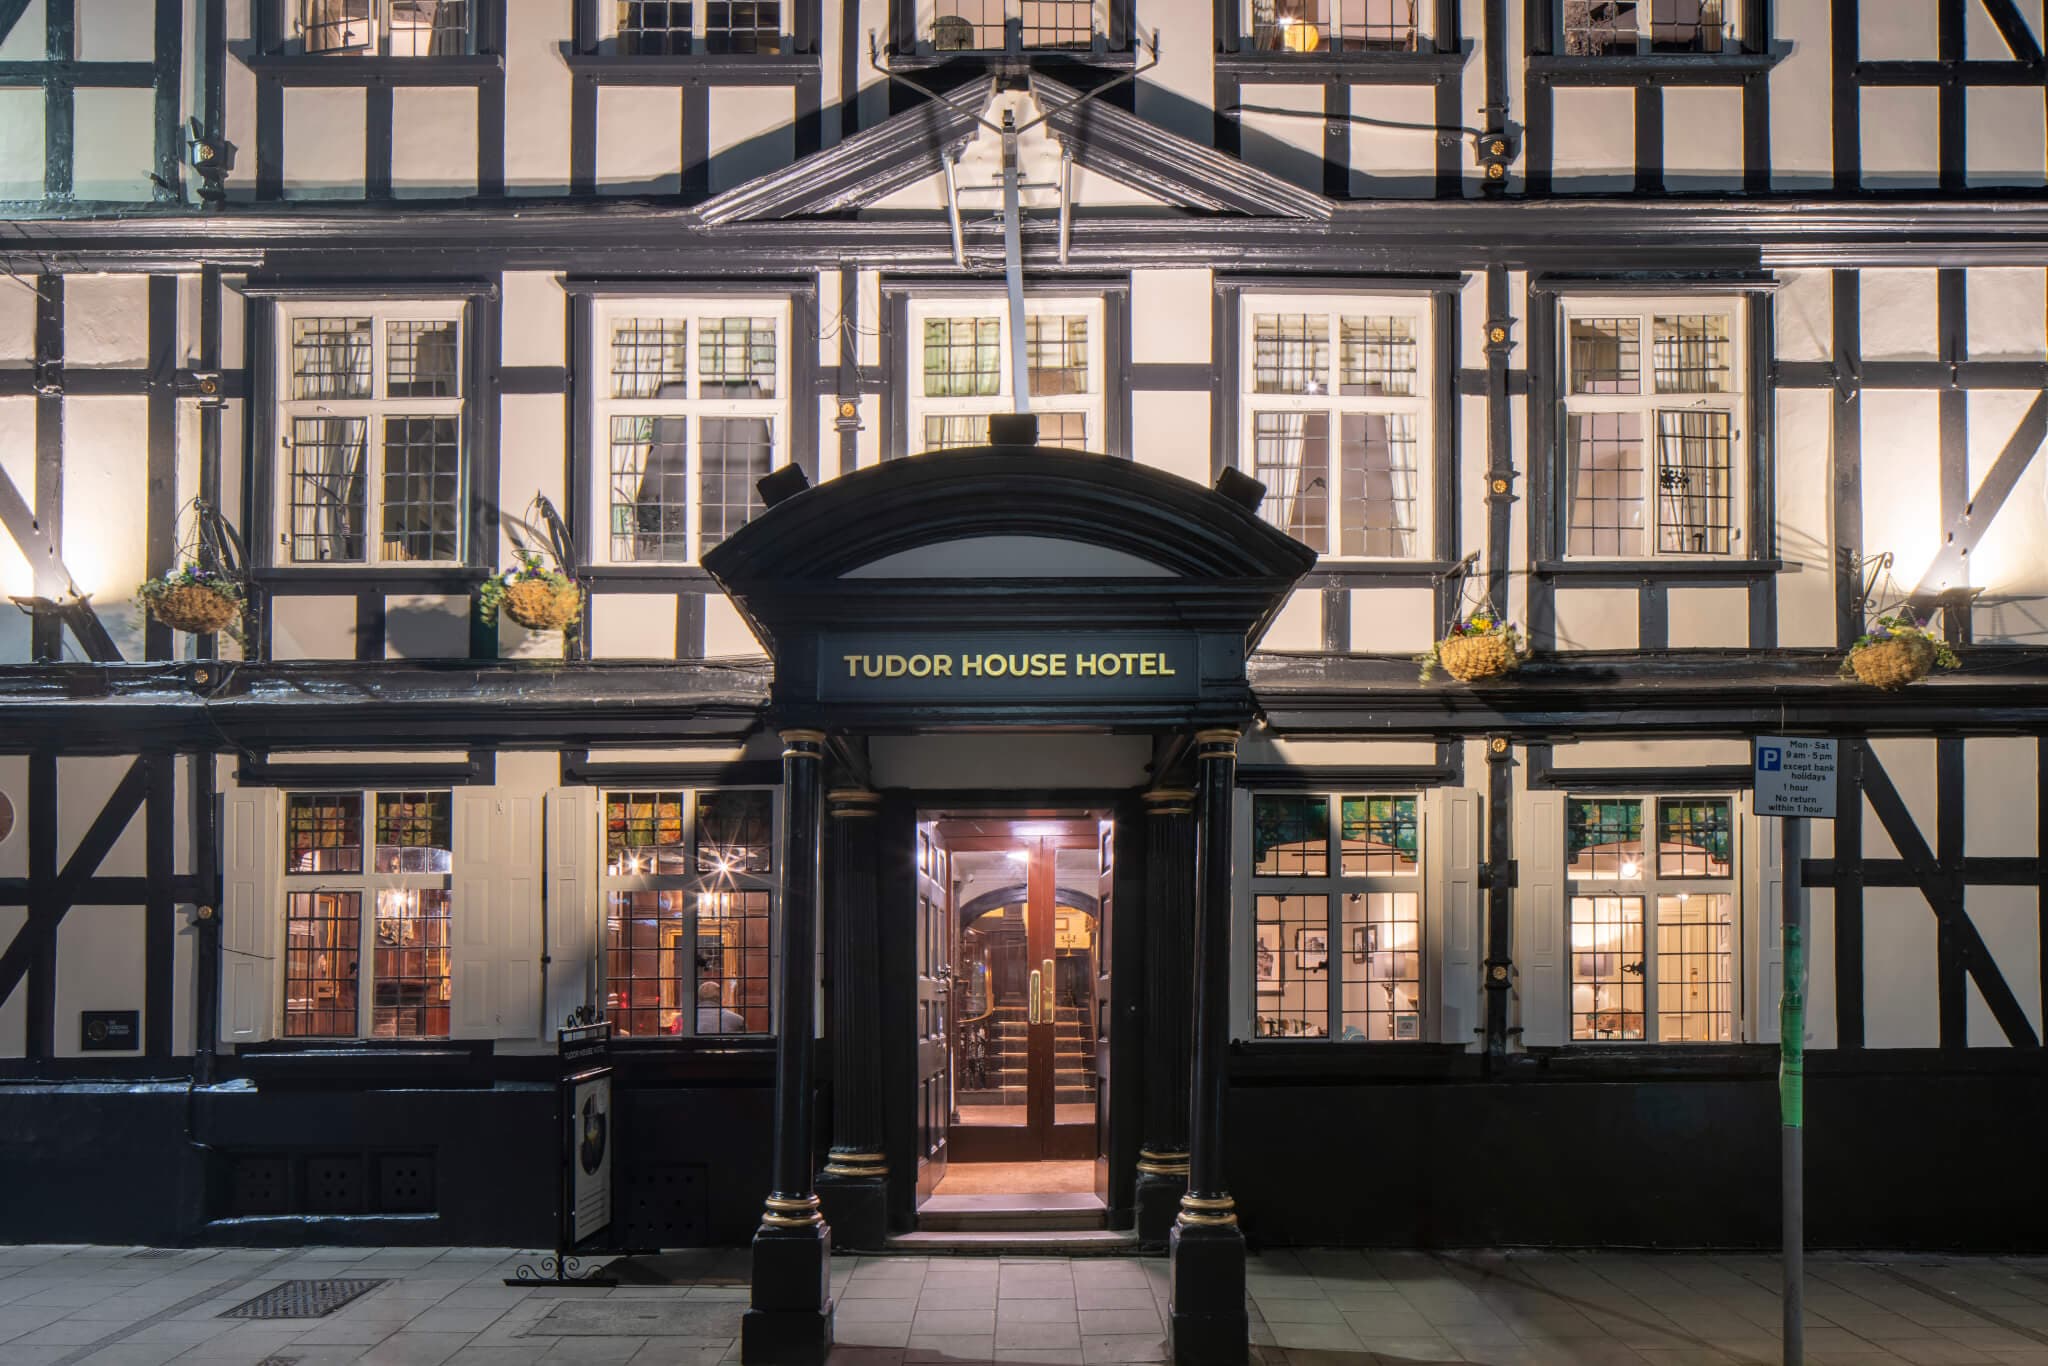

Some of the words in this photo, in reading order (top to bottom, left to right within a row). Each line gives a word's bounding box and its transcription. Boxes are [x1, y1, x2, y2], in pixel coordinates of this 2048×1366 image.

[843, 653, 953, 677] TUDOR
[961, 653, 1067, 677] HOUSE
[1075, 652, 1176, 676] HOTEL
[1790, 740, 1808, 749] Mon
[1814, 742, 1830, 750] Sat
[1764, 750, 1777, 769] P
[1783, 763, 1812, 772] except
[1814, 763, 1835, 772] bank
[1791, 772, 1827, 782] holidays
[1789, 784, 1808, 792] hour
[1775, 794, 1788, 802] No
[1790, 796, 1817, 804] return
[1768, 803, 1795, 812] within
[1803, 804, 1824, 813] hour
